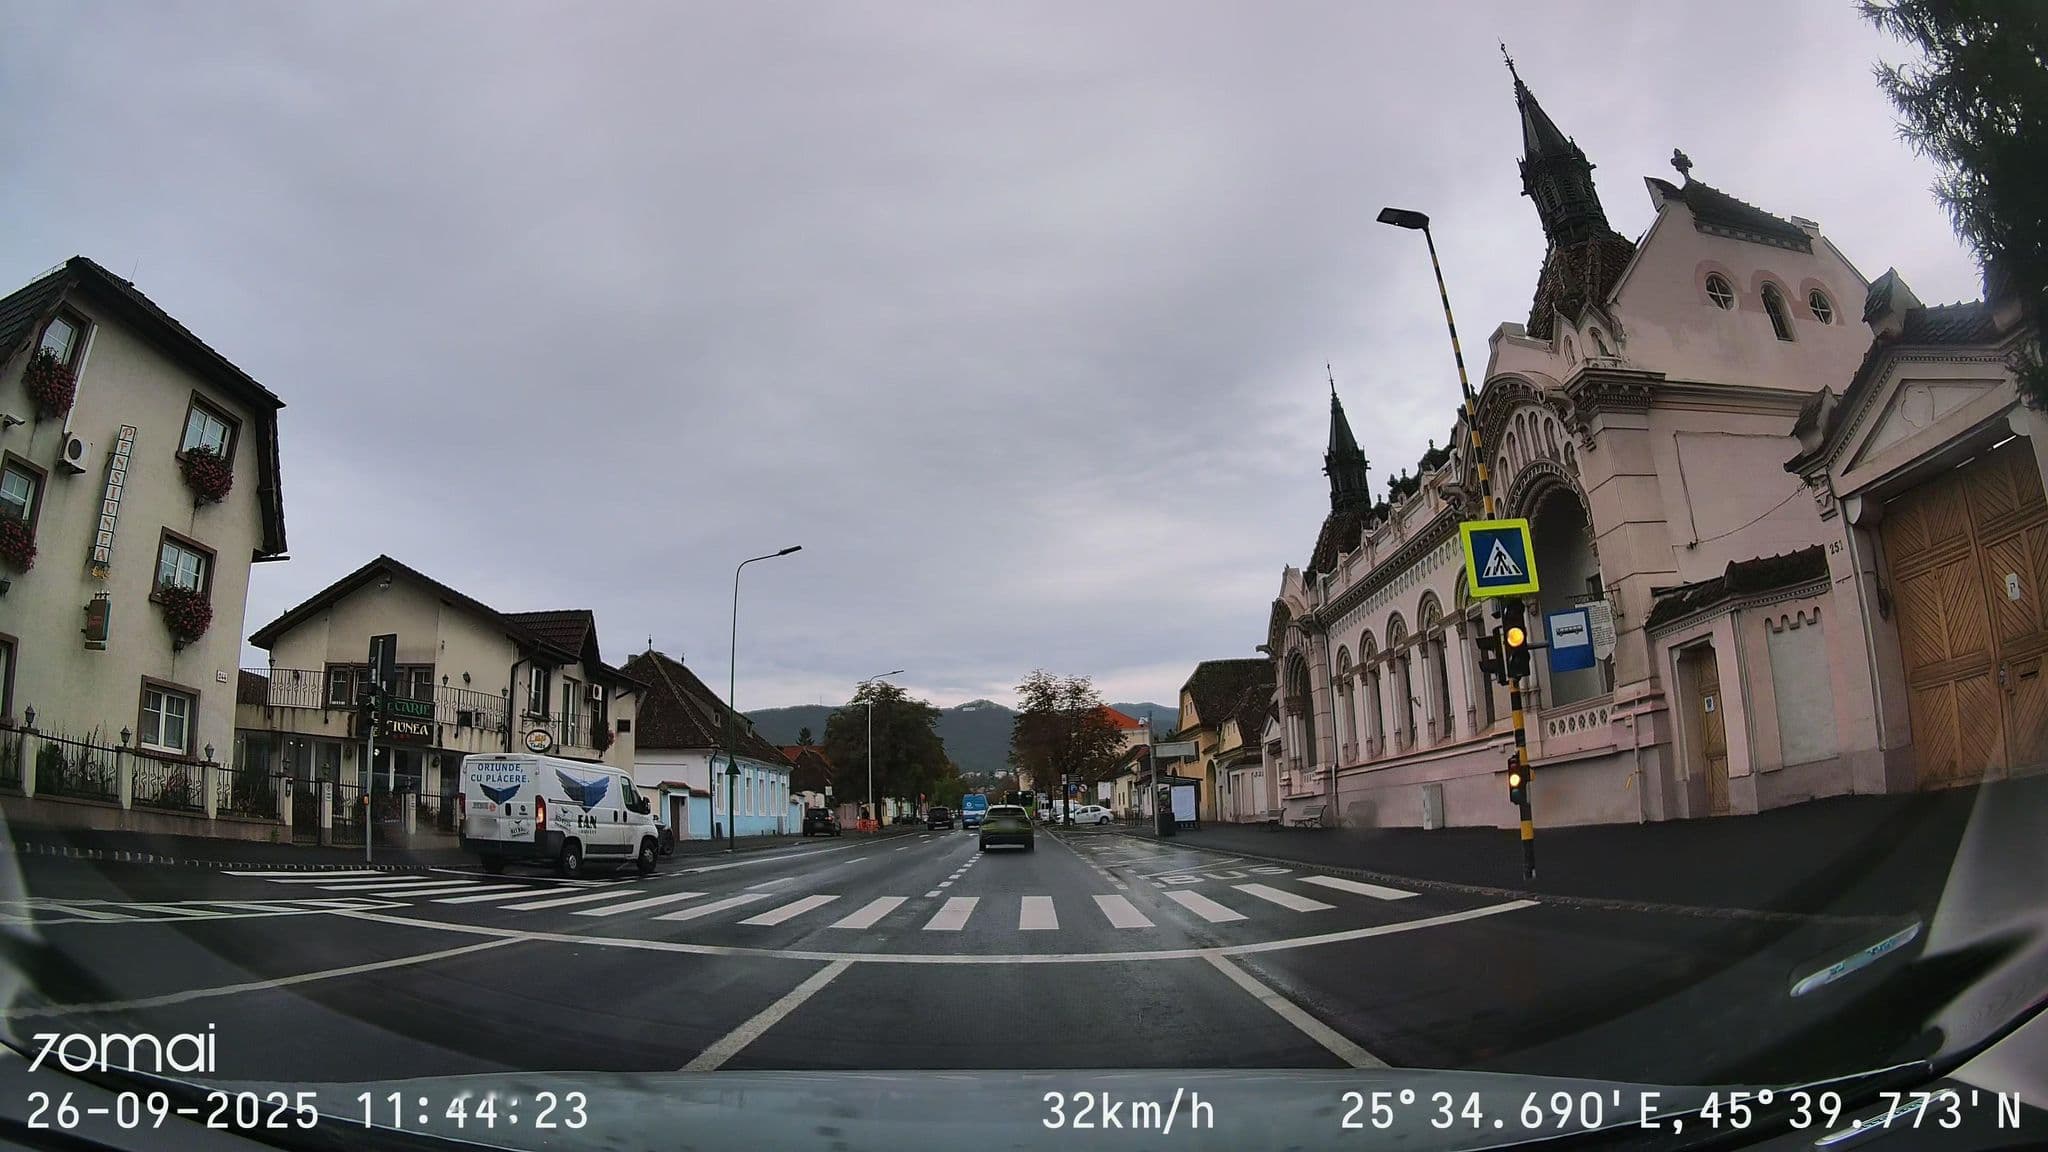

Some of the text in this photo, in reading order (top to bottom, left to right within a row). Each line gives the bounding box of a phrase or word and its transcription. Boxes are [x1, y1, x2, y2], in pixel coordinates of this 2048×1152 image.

[96, 427, 133, 561] PENSIUNEA
[477, 763, 523, 773] ORIUNDE,
[470, 774, 482, 782] CU
